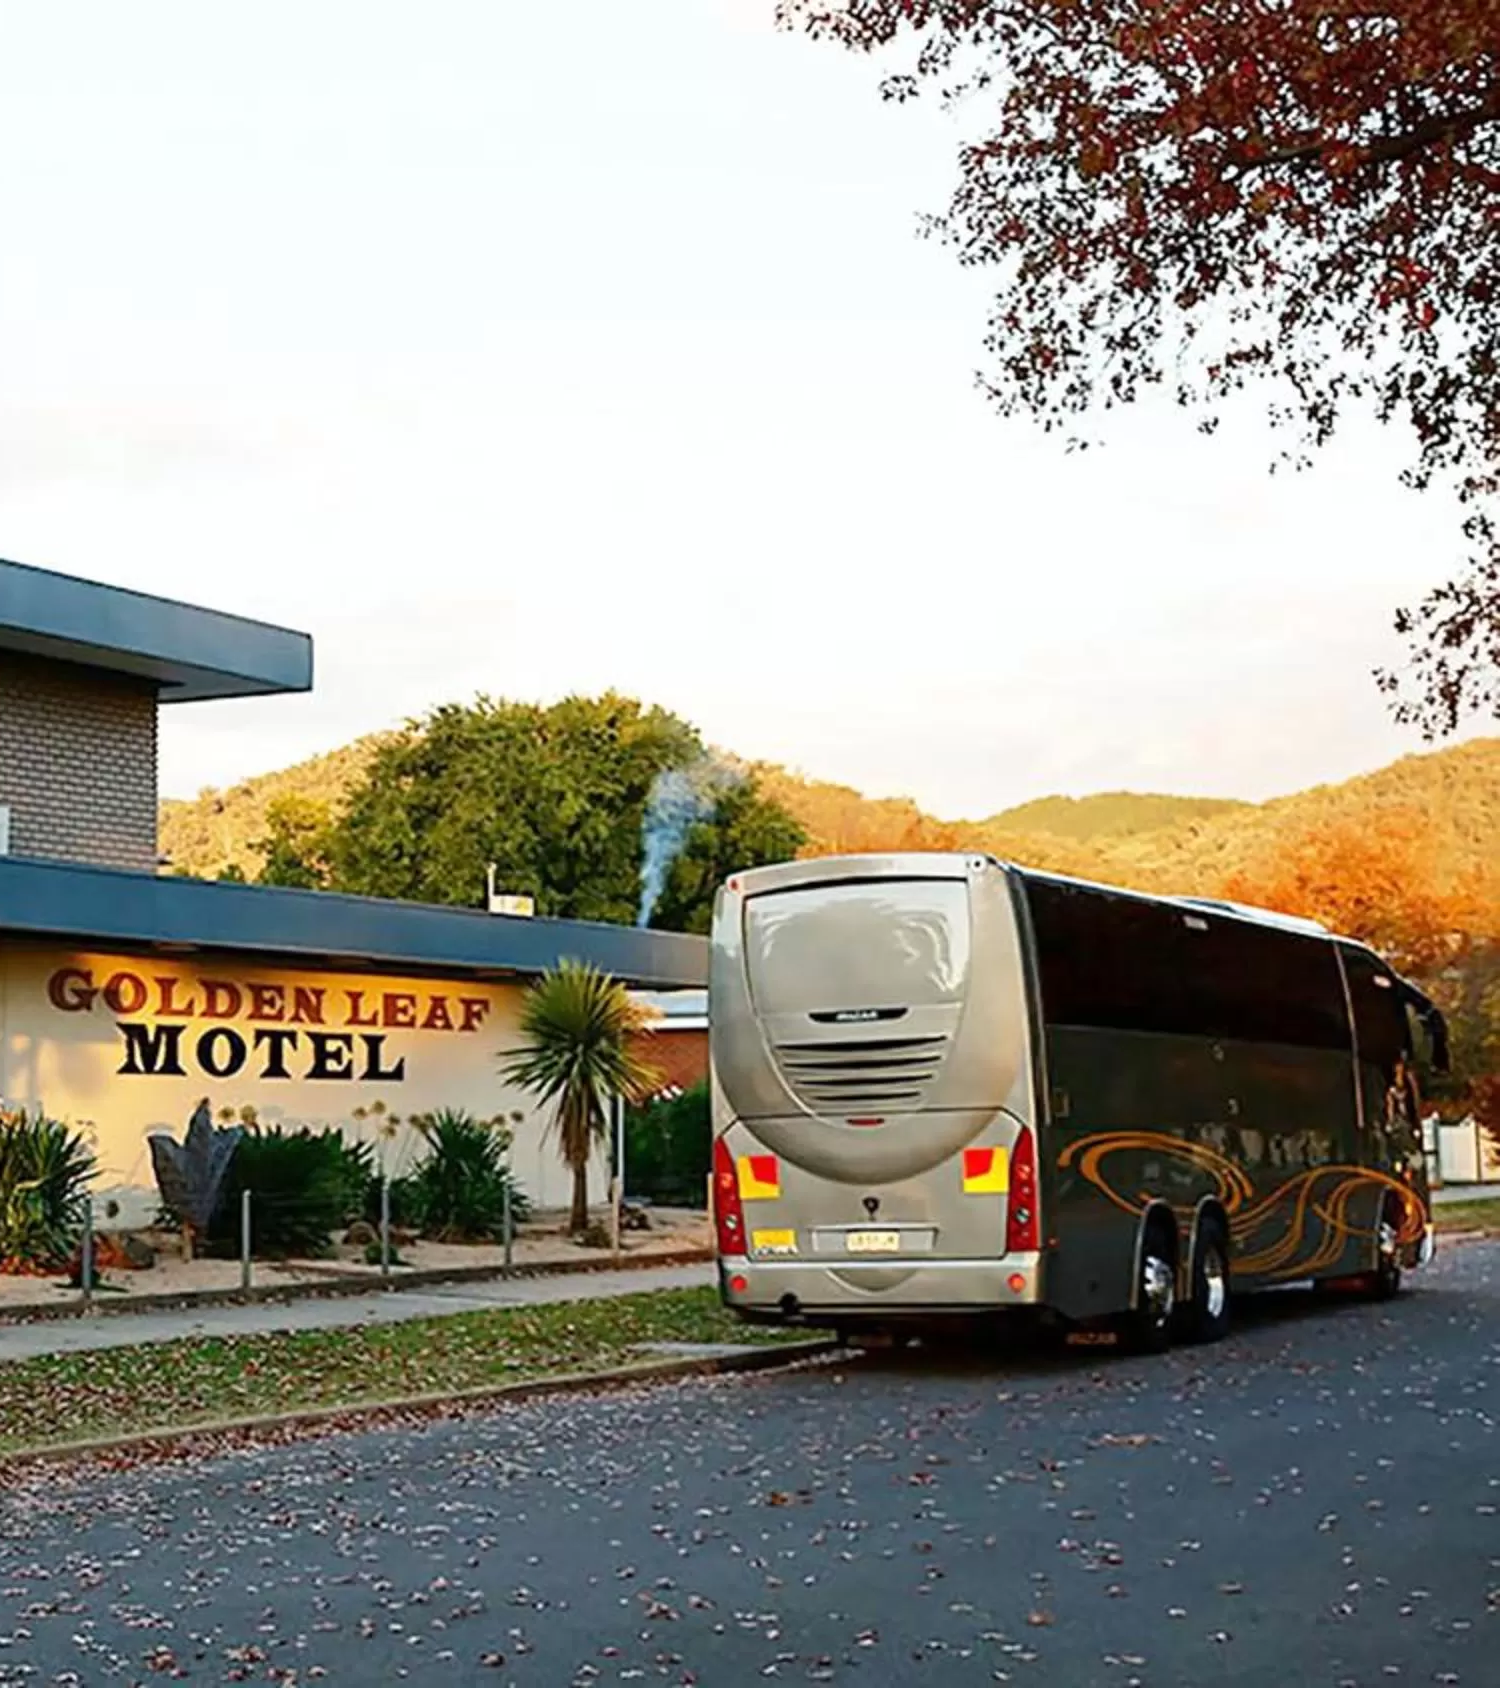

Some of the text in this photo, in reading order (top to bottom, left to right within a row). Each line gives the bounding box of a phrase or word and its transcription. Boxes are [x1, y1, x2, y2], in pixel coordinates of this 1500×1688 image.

[49, 969, 491, 1033] GOLDEN LEAF
[116, 1021, 406, 1081] MOTEL
